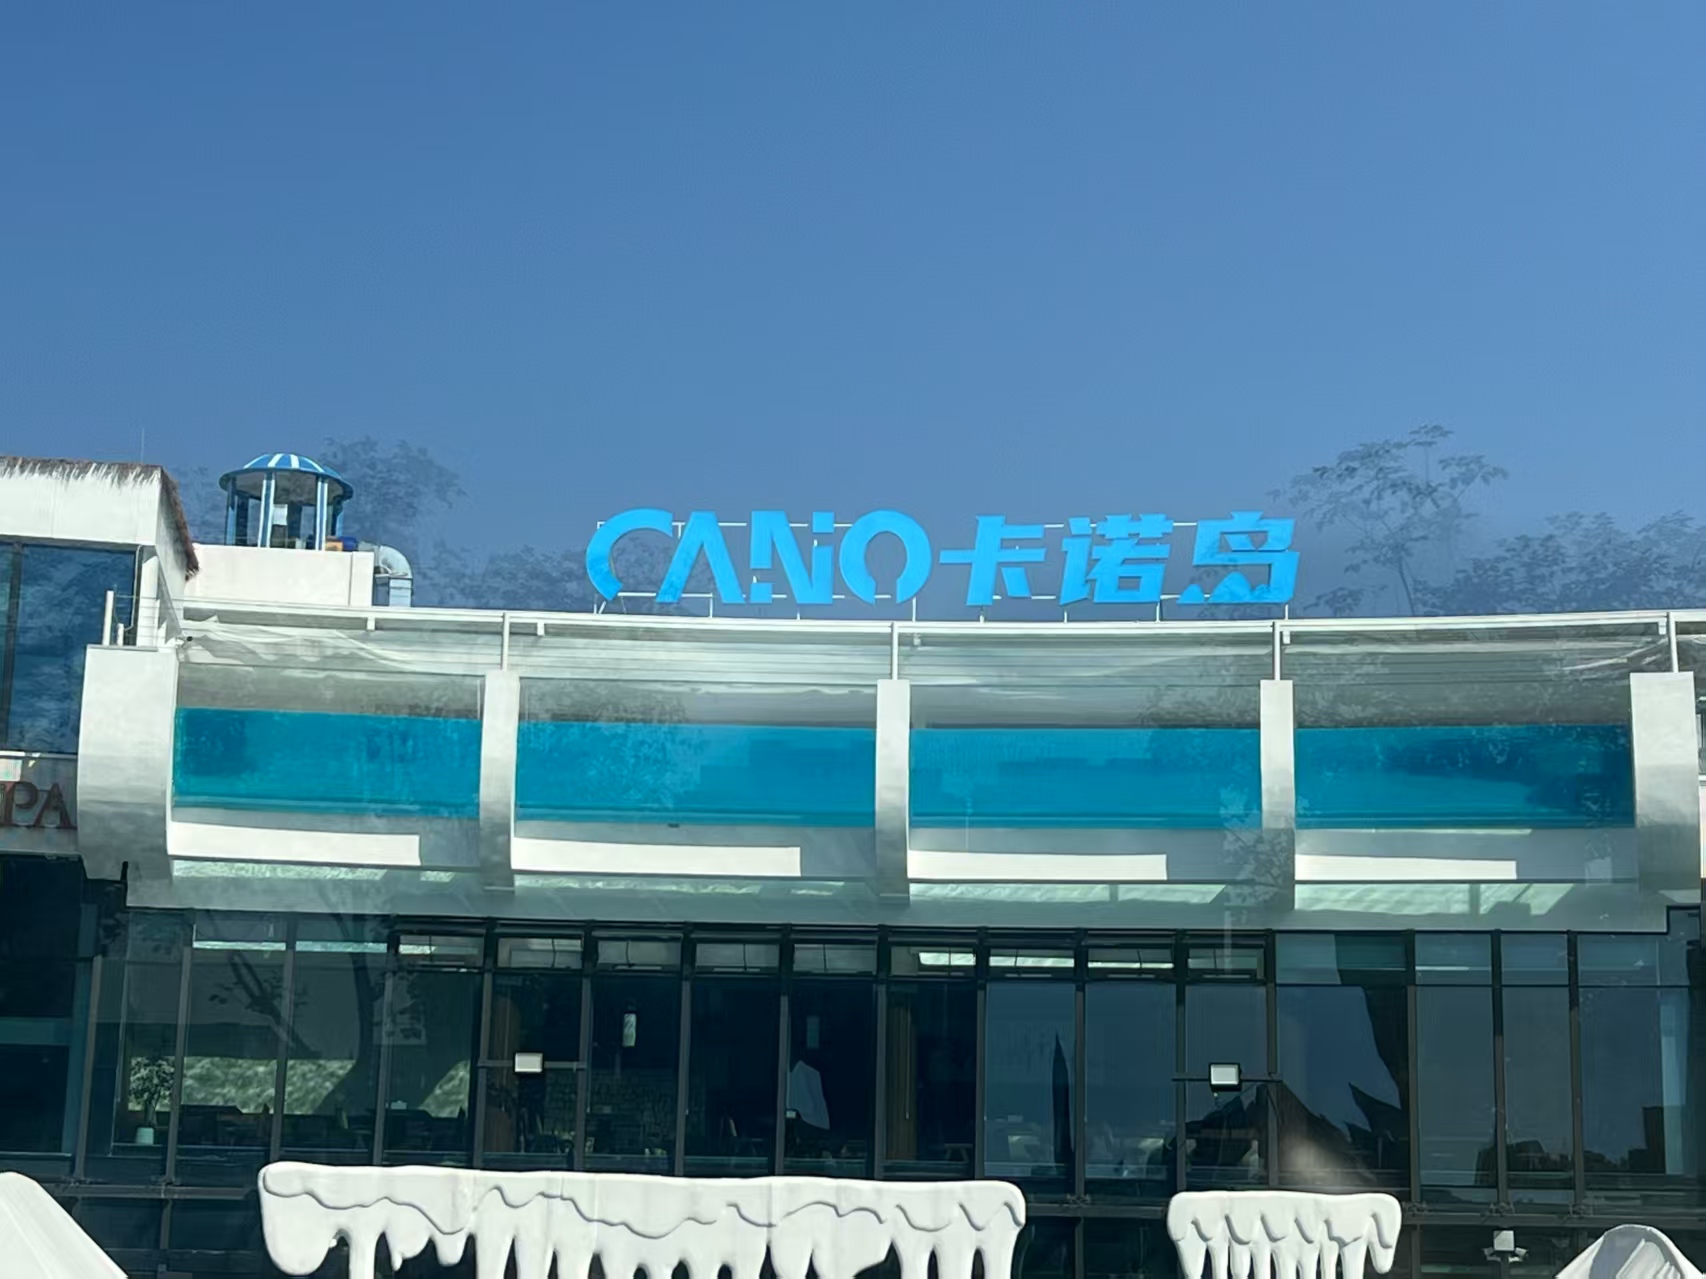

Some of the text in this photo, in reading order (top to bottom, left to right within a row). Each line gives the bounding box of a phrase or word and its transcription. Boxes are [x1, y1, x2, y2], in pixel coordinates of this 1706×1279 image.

[585, 508, 1301, 605] CANO 卡诺岛
